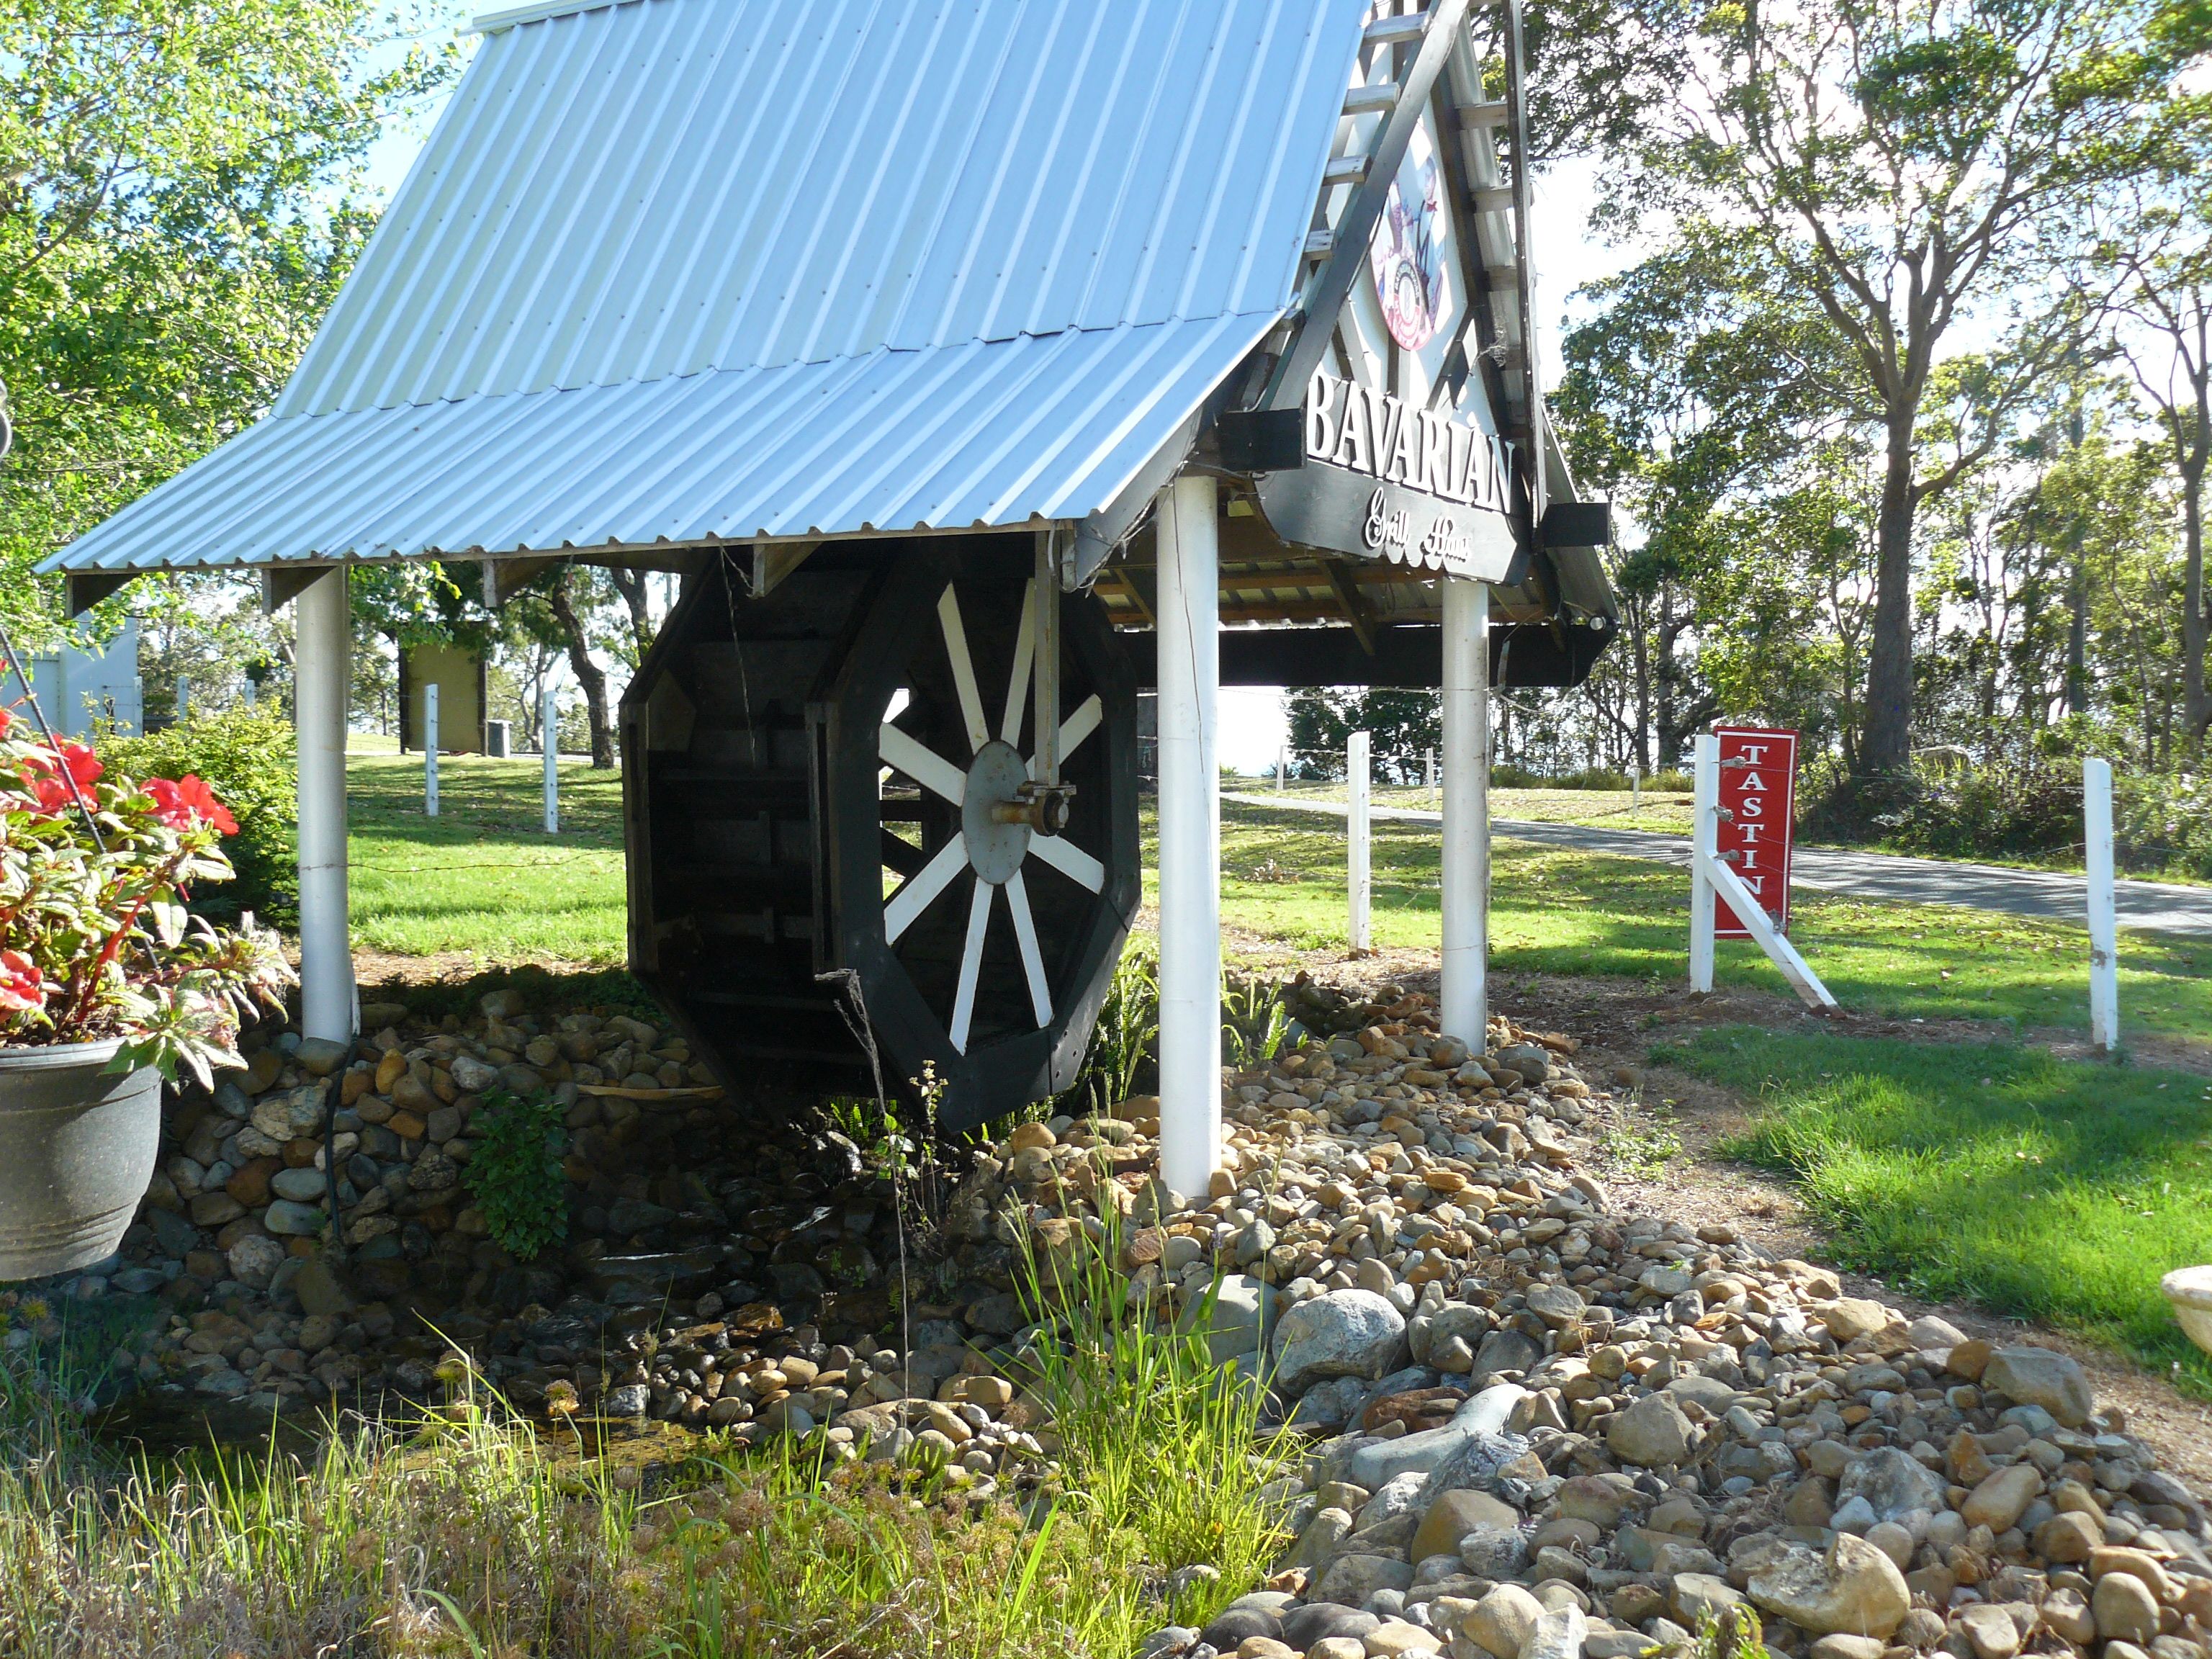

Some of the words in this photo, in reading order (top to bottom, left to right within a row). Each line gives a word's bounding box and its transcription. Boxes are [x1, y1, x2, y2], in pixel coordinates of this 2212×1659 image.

[1306, 372, 1515, 513] BAVARIAN
[1365, 486, 1411, 548] Grill
[1737, 745, 1768, 907] TASTIN
